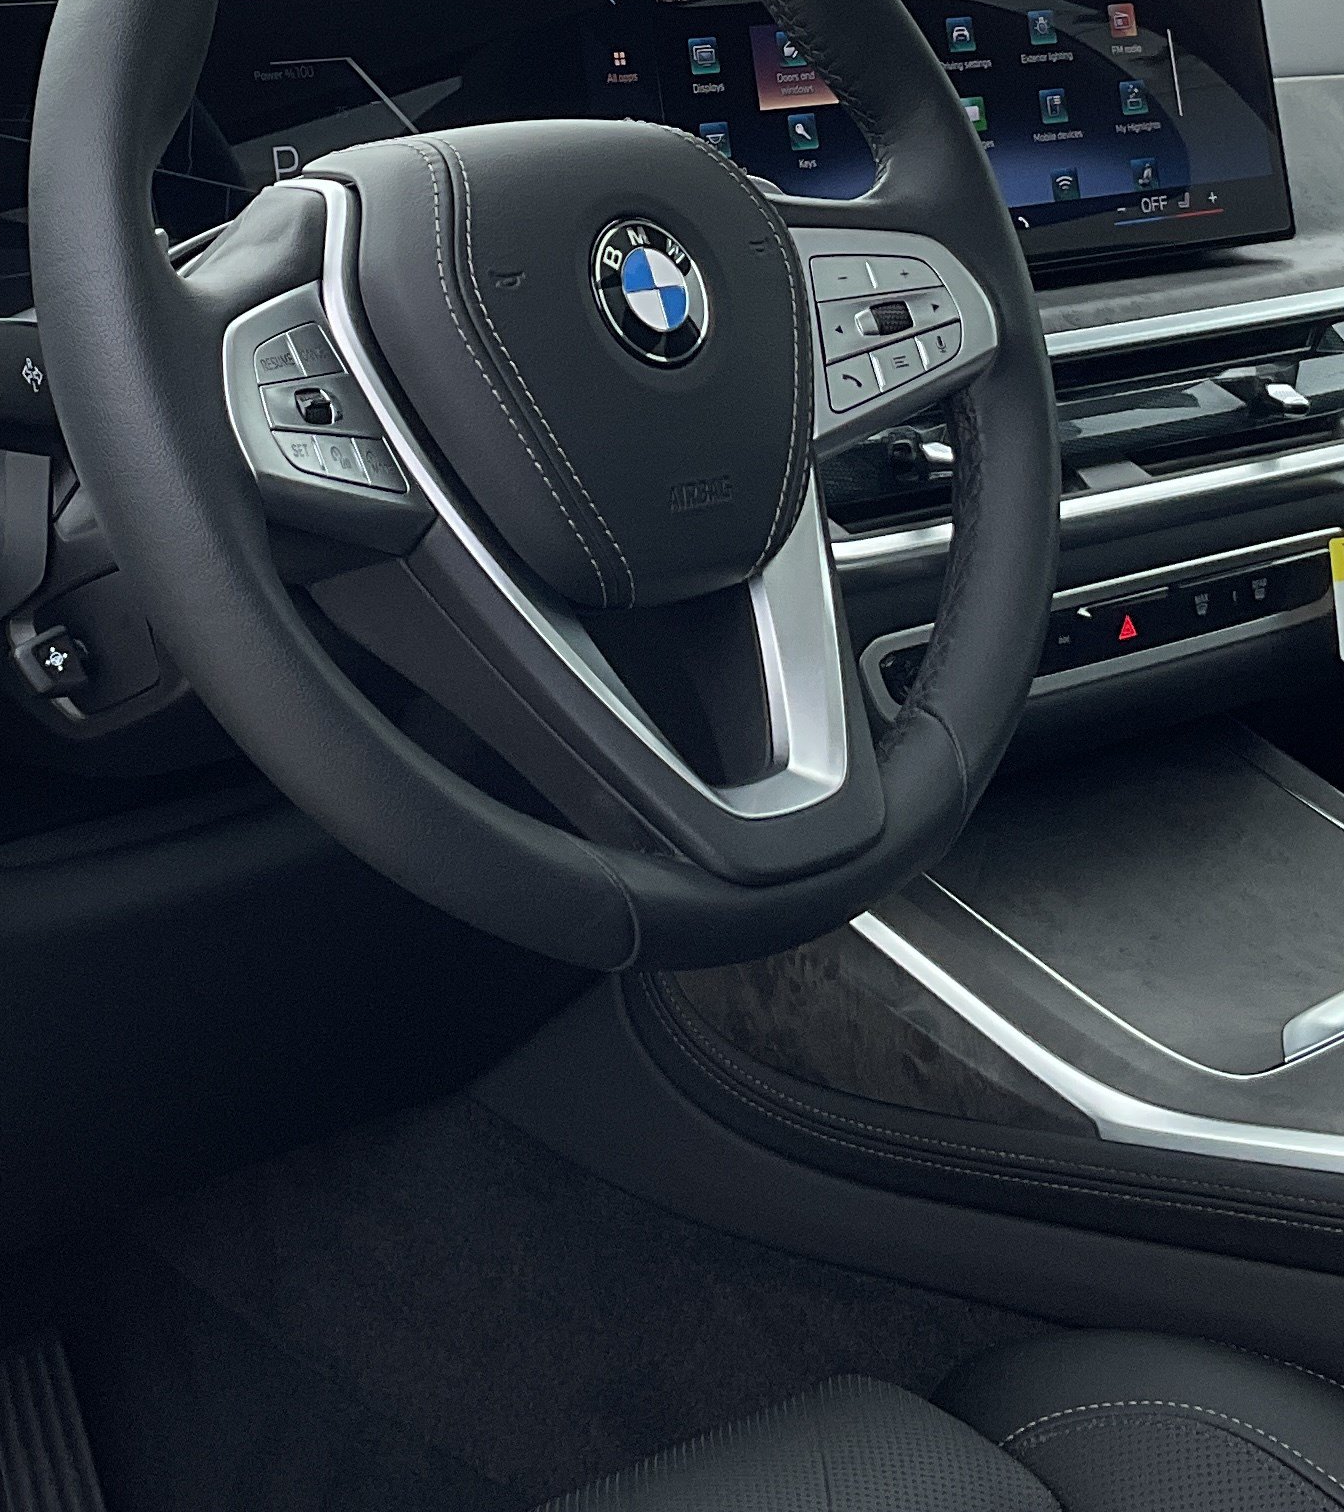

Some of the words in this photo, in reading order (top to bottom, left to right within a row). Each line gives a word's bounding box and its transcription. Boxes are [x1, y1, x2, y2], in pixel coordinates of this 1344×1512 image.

[1047, 51, 1074, 62] lighting
[777, 72, 799, 83] Doors
[692, 82, 725, 95] Displays
[1033, 132, 1056, 143] Mobile
[1057, 130, 1084, 141] devices
[272, 145, 299, 180] P
[798, 158, 817, 171] Keys
[1140, 194, 1168, 214] OFF
[602, 226, 686, 271] BMW
[290, 443, 309, 458] SET
